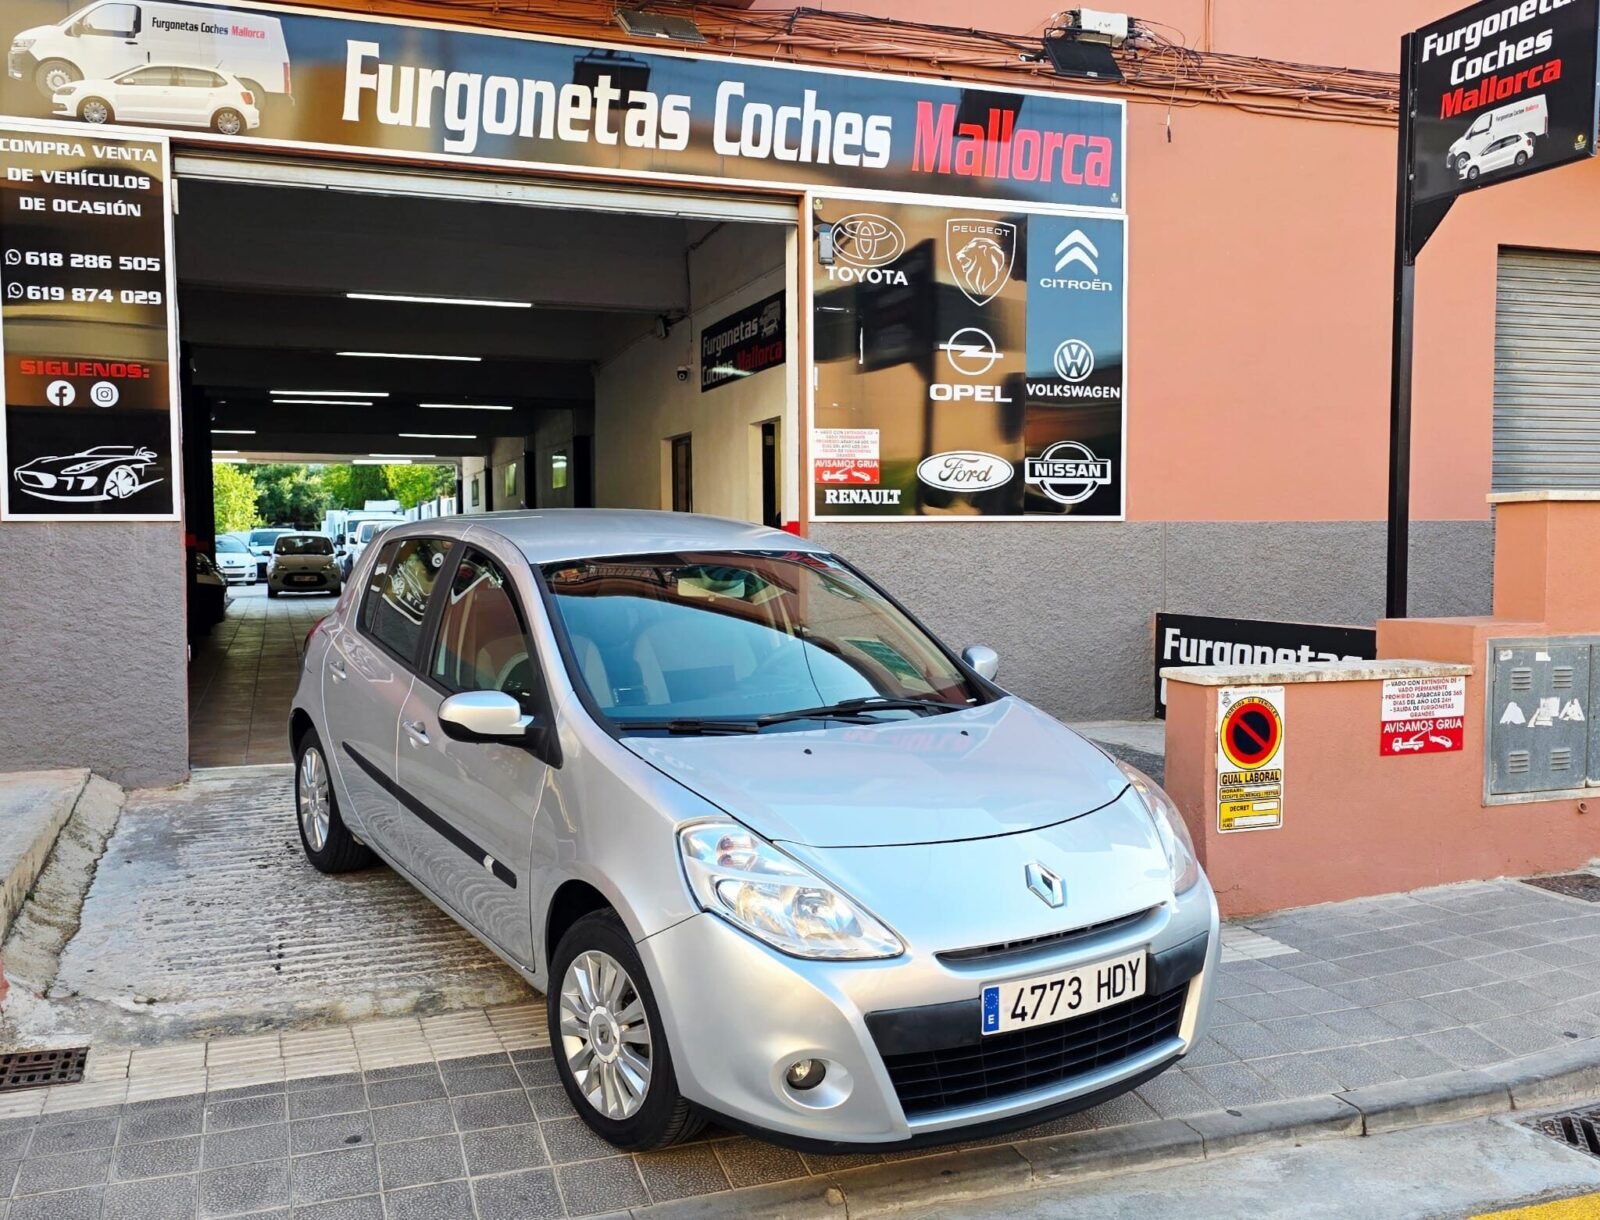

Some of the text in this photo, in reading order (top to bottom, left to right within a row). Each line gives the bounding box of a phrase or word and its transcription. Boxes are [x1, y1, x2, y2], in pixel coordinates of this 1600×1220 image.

[152, 17, 265, 39] Furgonetas Coches Mallorca
[1450, 28, 1553, 86] Coches
[1440, 58, 1562, 120] Mallorca
[341, 39, 1113, 188] Furgonetas Coches Mallorca
[0, 138, 158, 162] COMPRA VENTA
[7, 167, 151, 190] DE VEHÍCULOS
[19, 196, 141, 217] DE OCASIÓN
[952, 225, 1011, 237] PEUGEOT
[25, 251, 161, 272] 618 286 505
[825, 265, 908, 286] TOYOTA
[1040, 278, 1113, 291] CITROËN
[27, 286, 162, 305] 619 874 029
[703, 318, 758, 357] Furgonetas
[929, 383, 1013, 403] OPEL
[1026, 382, 1121, 399] VOLKSWAGEN
[815, 460, 878, 468] AVISAMOS GRUA
[938, 457, 992, 483] Ford
[1035, 462, 1101, 477] NISSAN
[824, 489, 901, 504] RENAULT
[1163, 628, 1363, 666] Furgonet
[1383, 719, 1463, 733] AVISAMOS GRUA
[1222, 771, 1279, 784] GUAL LABORAL
[1010, 958, 1140, 1021] 4773 HDY
[988, 1014, 995, 1024] E
